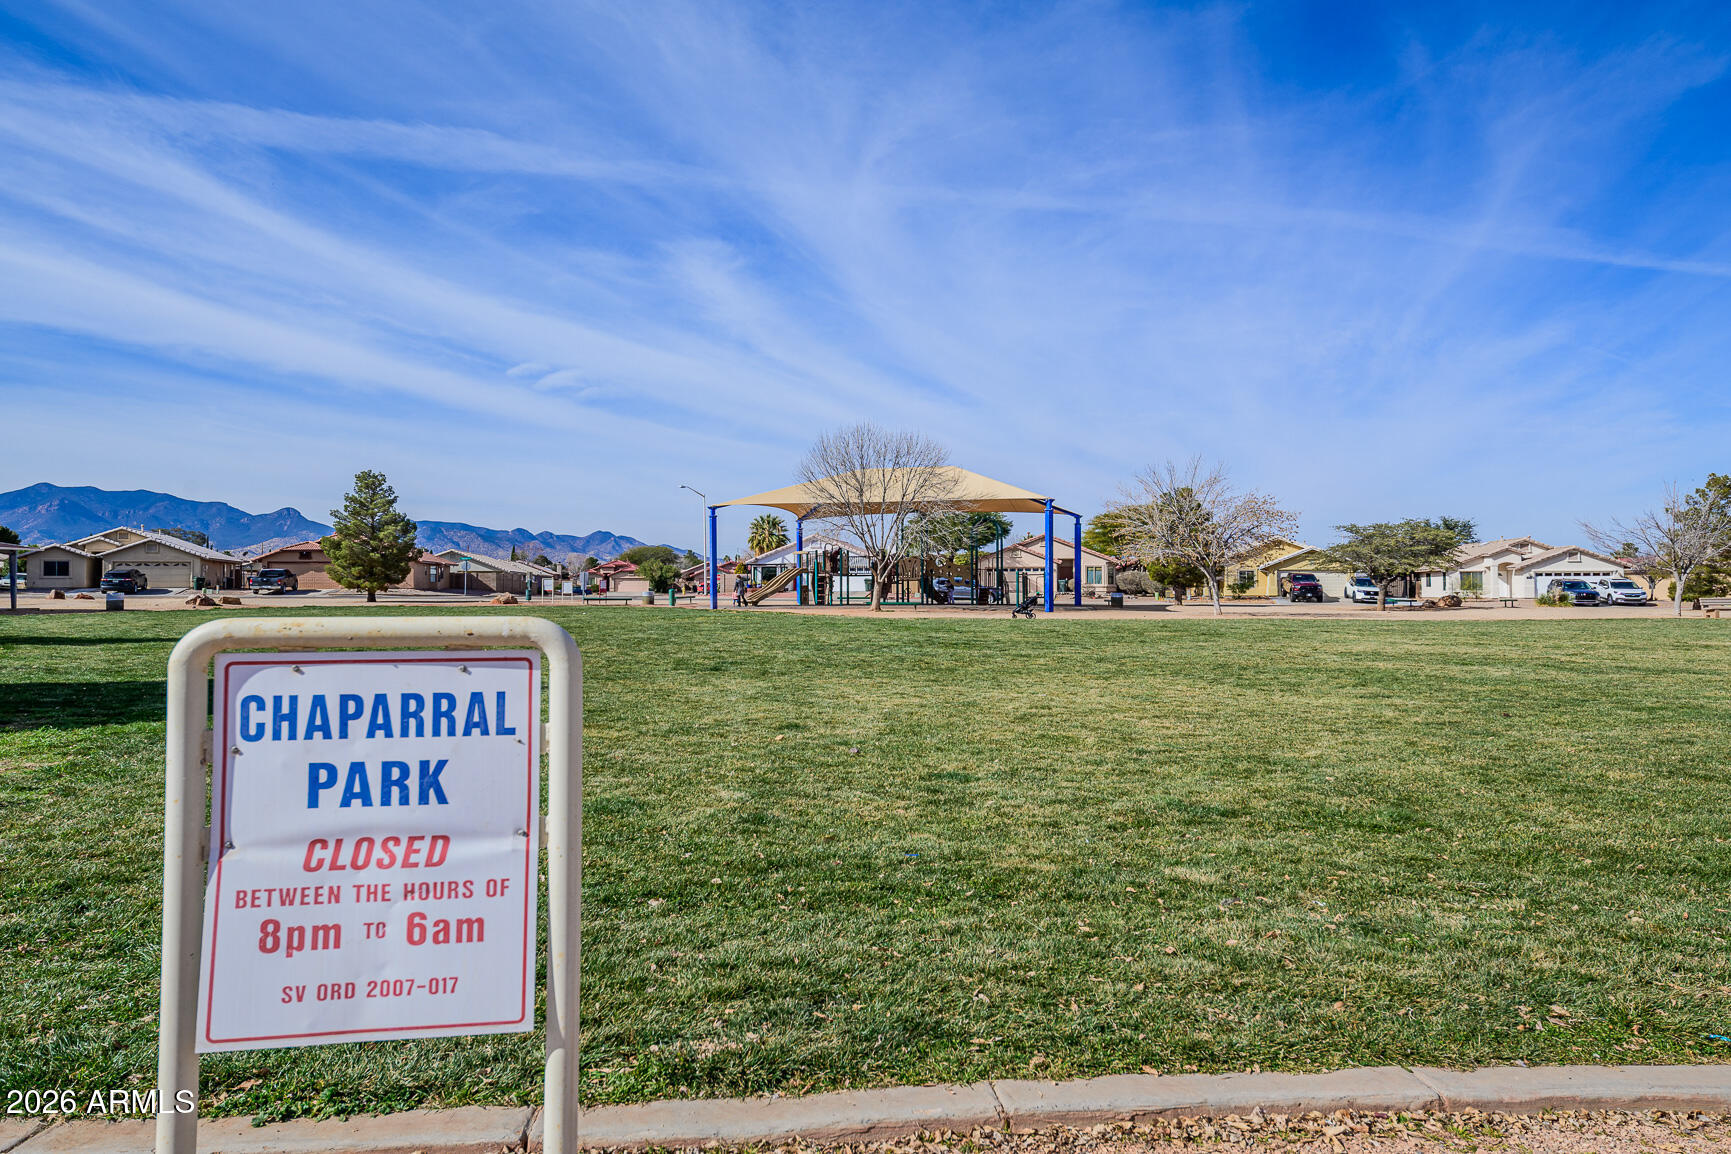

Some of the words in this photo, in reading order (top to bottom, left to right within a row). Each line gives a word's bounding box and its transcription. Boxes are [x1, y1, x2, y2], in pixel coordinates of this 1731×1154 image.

[240, 691, 516, 742] CHAPARRAL
[307, 760, 449, 808] PARK
[303, 835, 451, 872] CLOSED
[235, 885, 341, 909] BETWEEN
[353, 884, 391, 903] THE
[404, 880, 473, 900] HOURS
[486, 878, 510, 897] OF
[259, 919, 341, 958] 8pm
[364, 922, 386, 939] TO
[406, 912, 484, 945] 6am
[282, 986, 306, 1003] SV
[317, 982, 355, 1001] ORD
[367, 977, 458, 998] 2007-017
